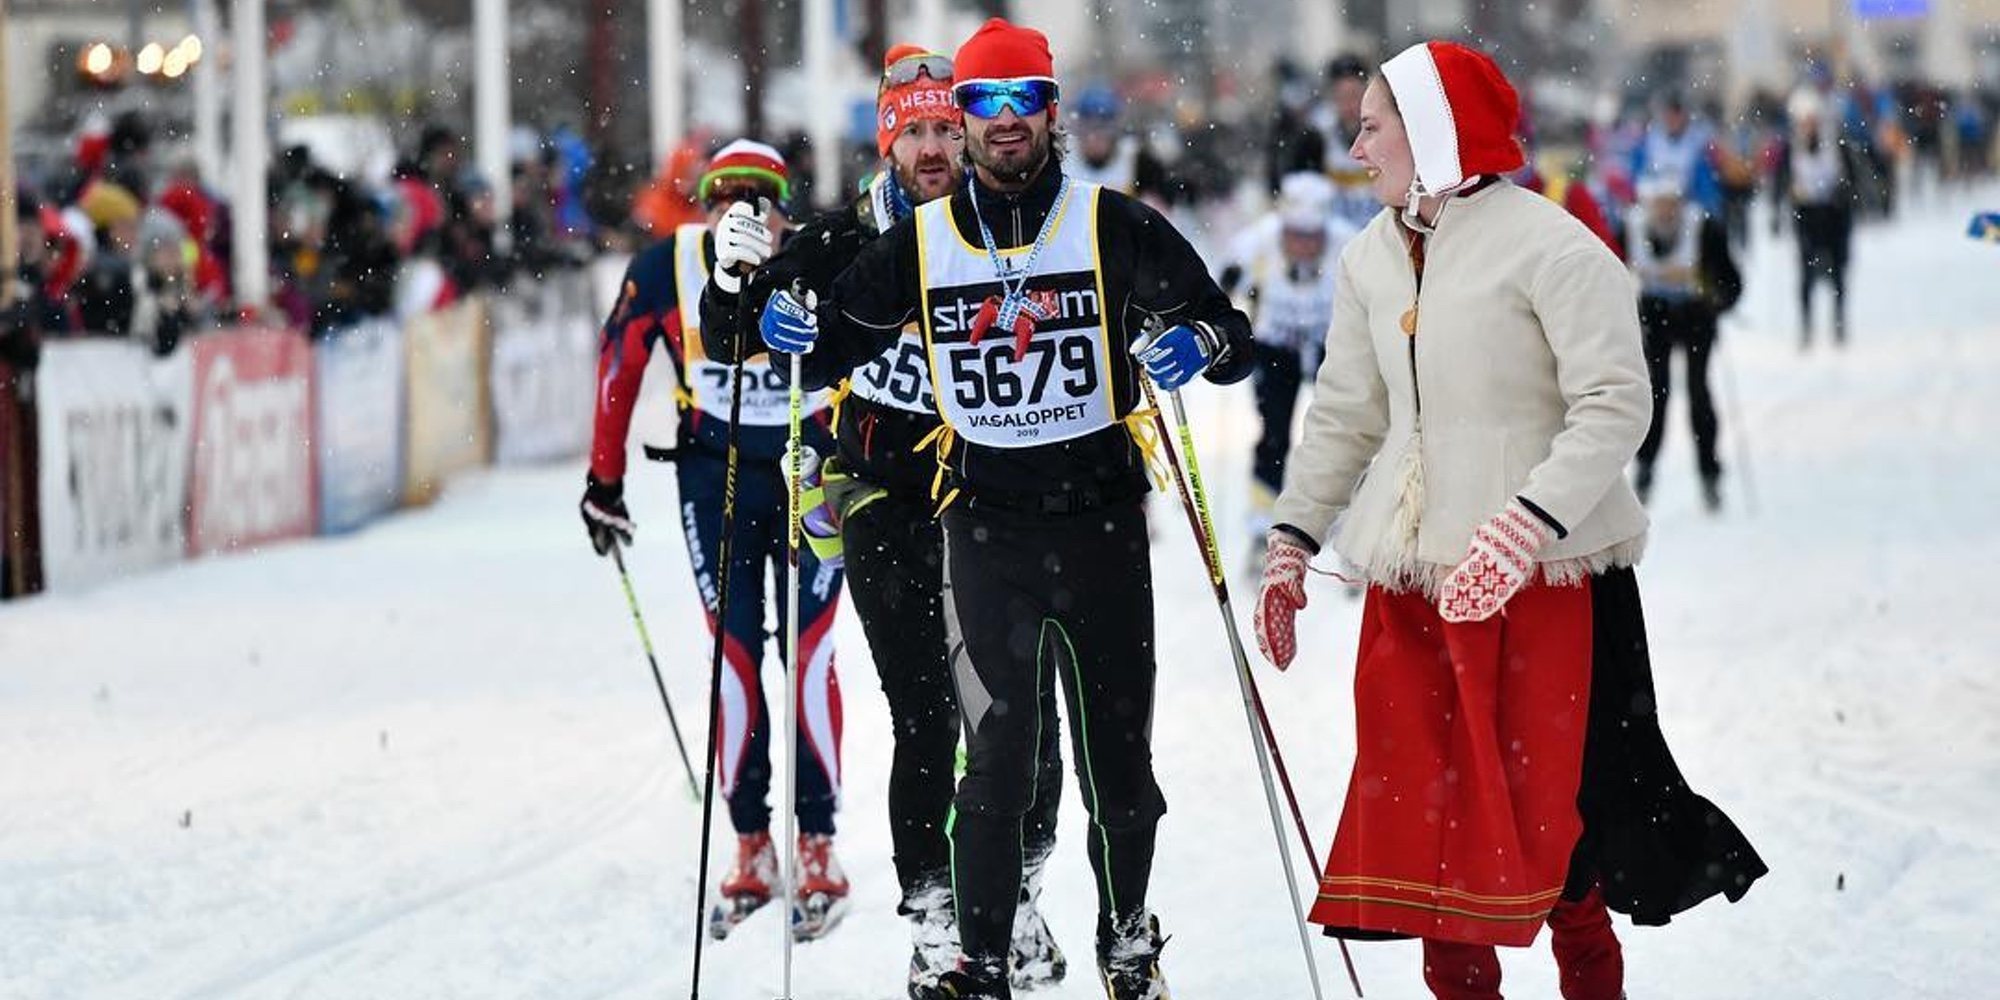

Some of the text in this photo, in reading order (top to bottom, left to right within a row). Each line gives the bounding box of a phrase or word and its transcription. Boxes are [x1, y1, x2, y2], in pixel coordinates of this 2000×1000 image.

[949, 334, 1098, 409] 5679
[967, 402, 1087, 428] VASALOPPET
[1016, 428, 1040, 438] 2019
[724, 445, 739, 519] SWIX
